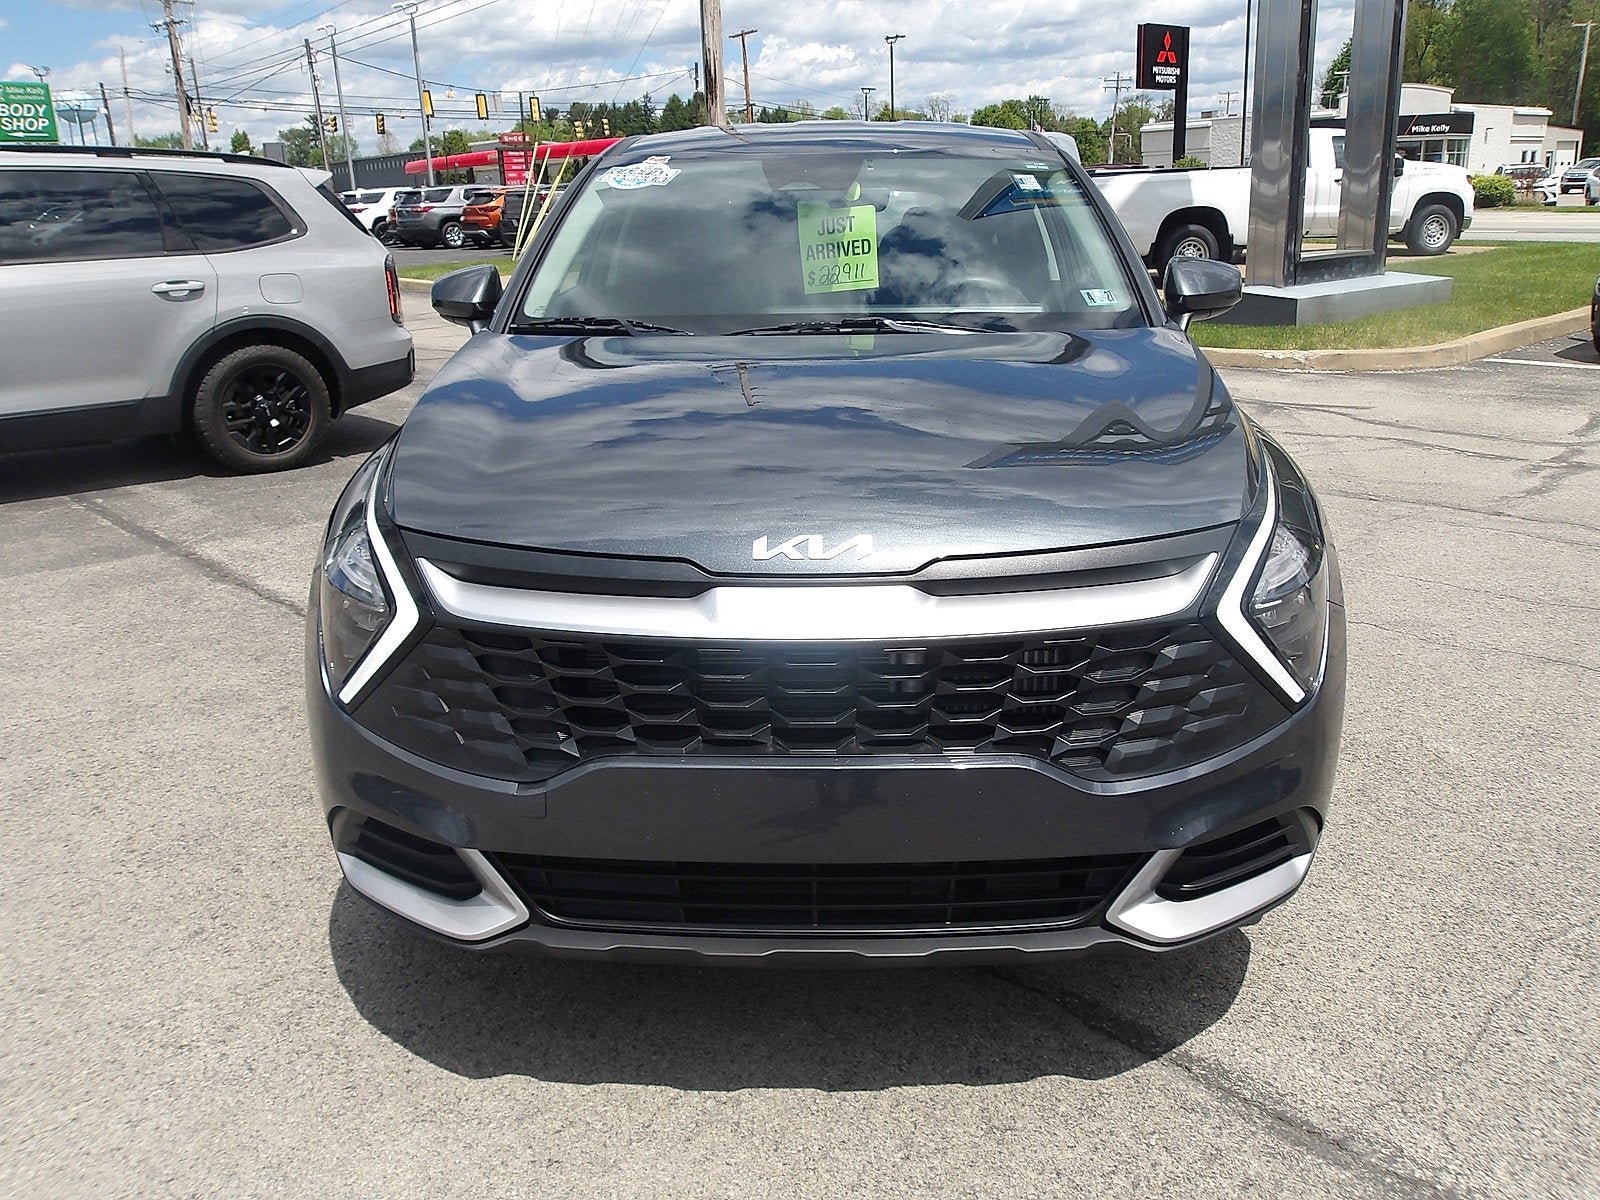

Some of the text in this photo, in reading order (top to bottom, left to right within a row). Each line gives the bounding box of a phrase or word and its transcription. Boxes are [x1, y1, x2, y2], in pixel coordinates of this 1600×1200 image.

[1152, 66, 1180, 75] MITSUBISHI
[1155, 75, 1177, 84] MOTORS
[0, 103, 47, 116] BODY
[1, 117, 49, 131] SHOP
[1411, 124, 1450, 133] Mike Kelly
[817, 215, 855, 236] JUST
[806, 238, 871, 261] ARRIVED
[752, 534, 873, 561] KIA
